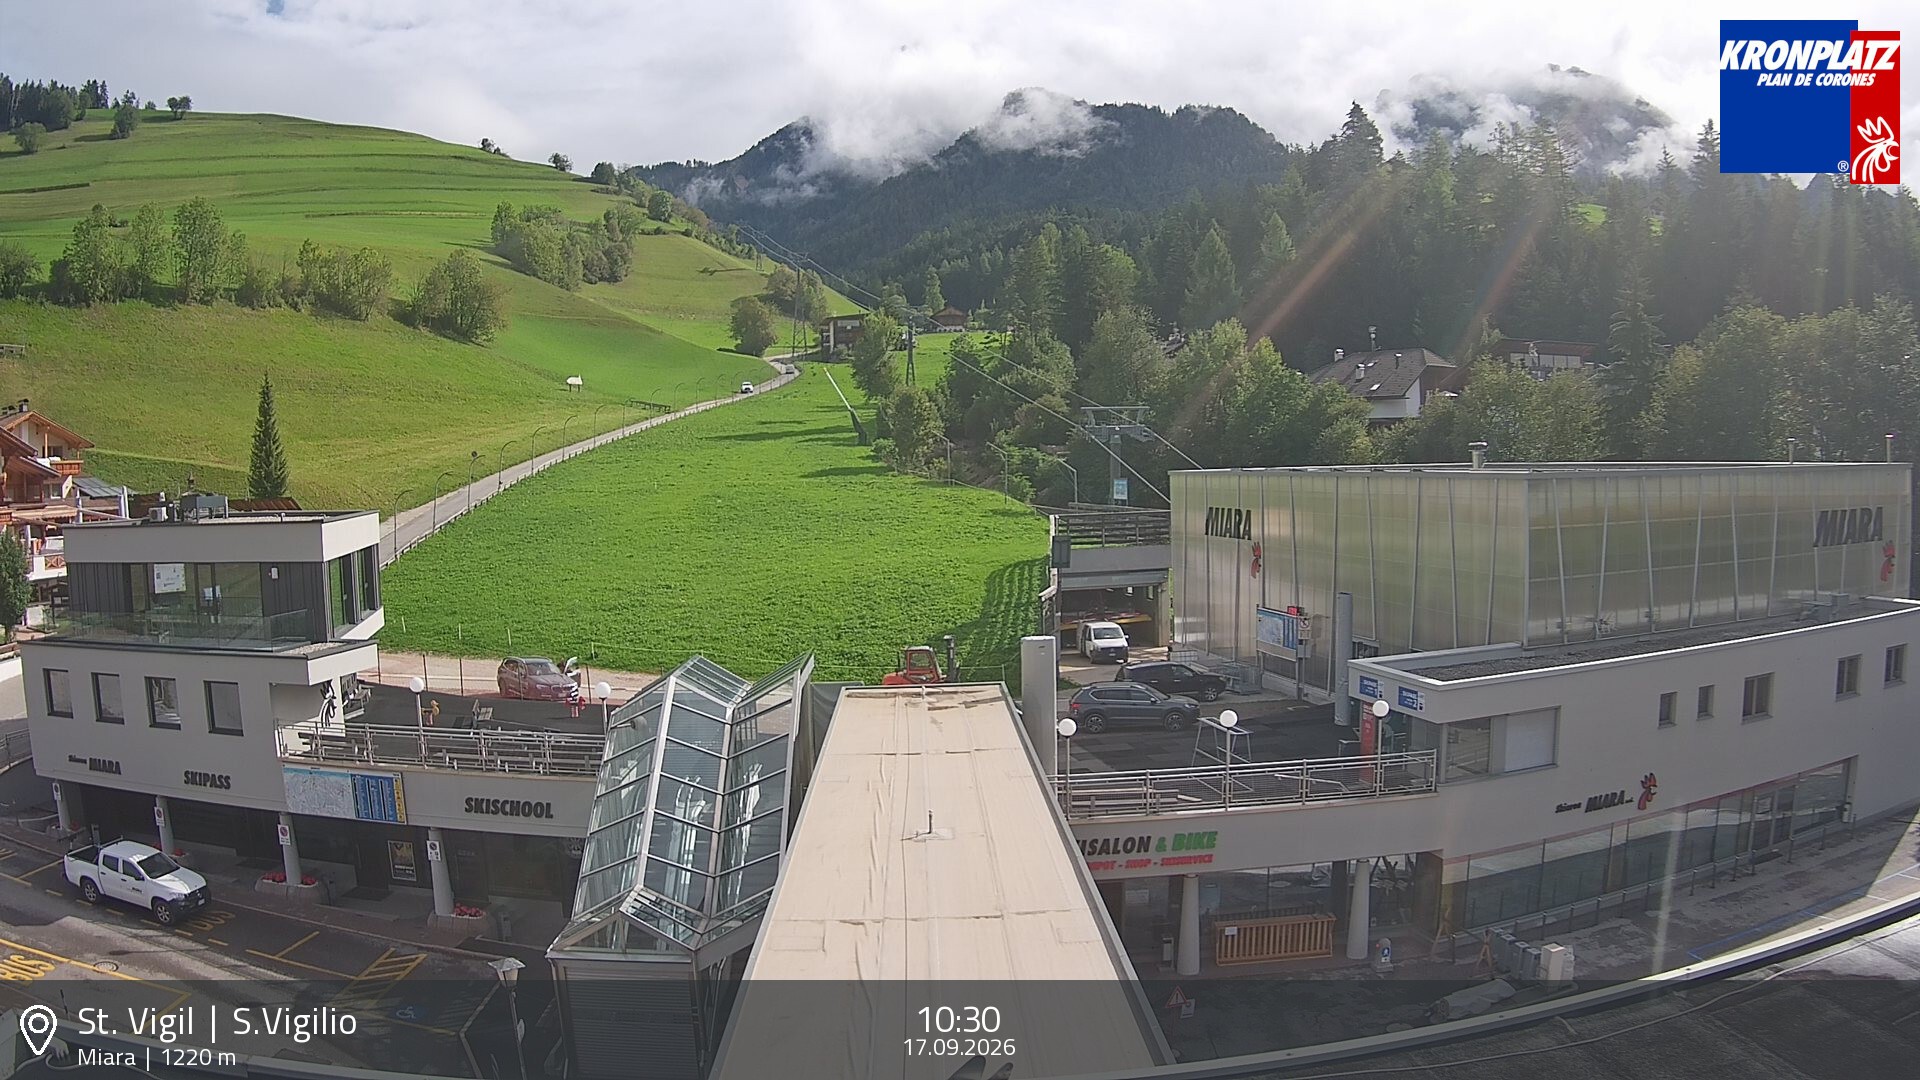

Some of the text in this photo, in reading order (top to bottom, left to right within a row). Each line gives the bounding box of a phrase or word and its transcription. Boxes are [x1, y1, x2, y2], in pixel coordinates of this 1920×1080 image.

[1205, 507, 1252, 540] MIARA
[1813, 506, 1883, 547] MIARA
[89, 757, 122, 775] MIARA
[184, 769, 231, 790] SKIPASS
[465, 797, 554, 819] SKISCHOOL
[1584, 790, 1625, 813] MIARA
[1077, 831, 1218, 856] ISALON & BIKE
[0, 954, 56, 985] BUS
